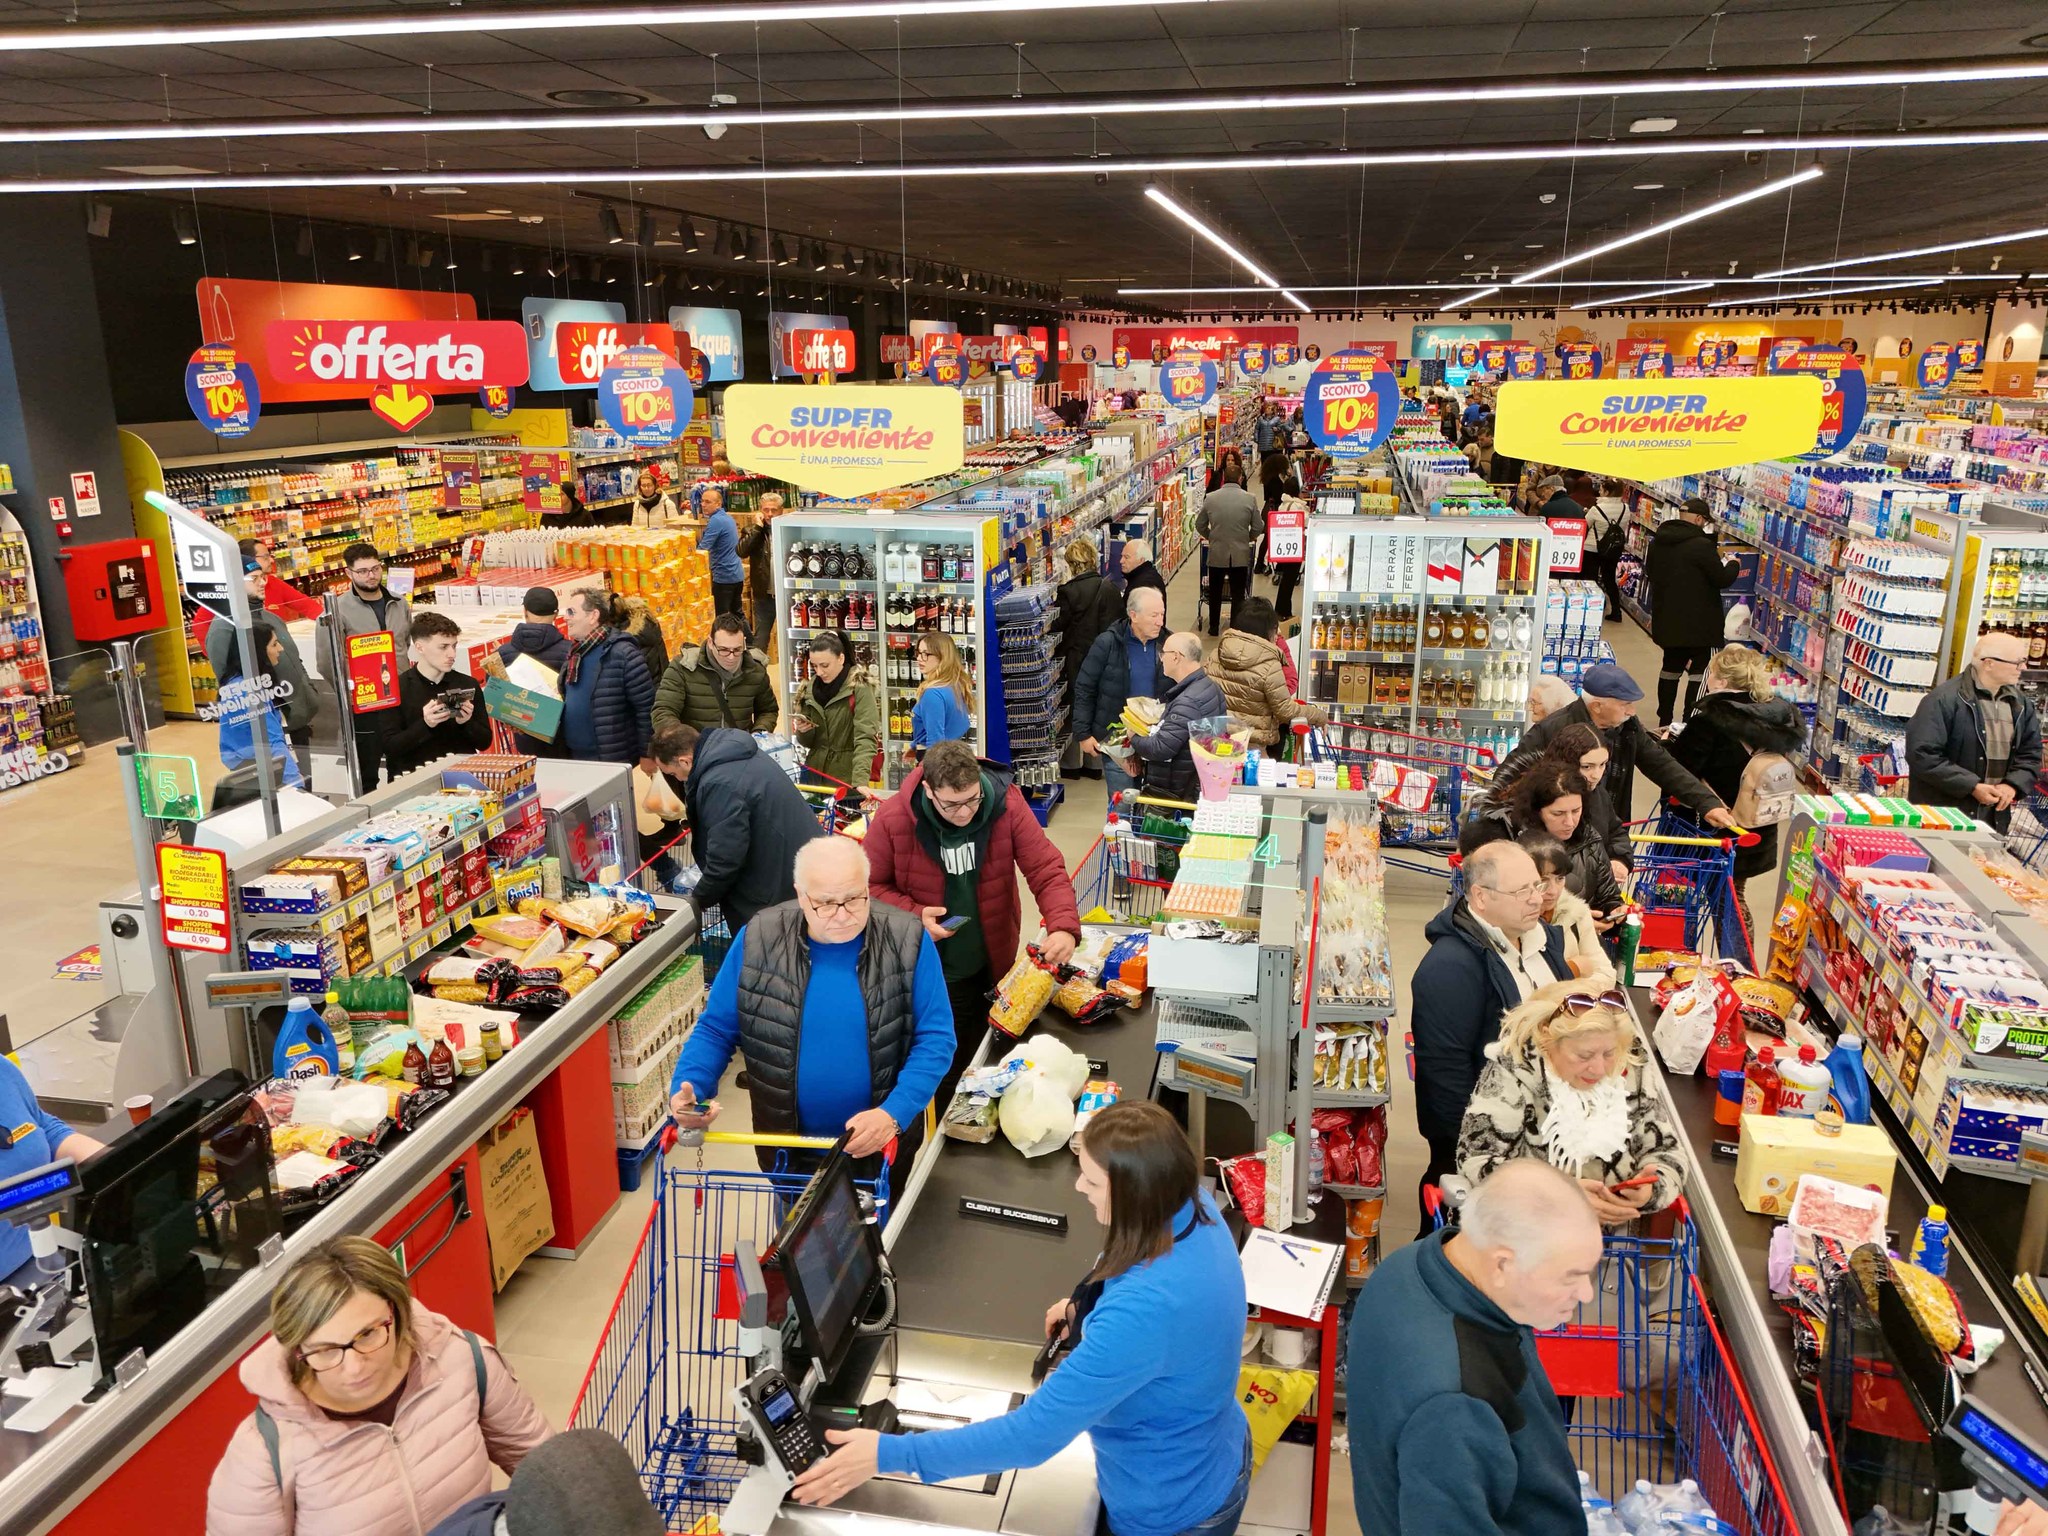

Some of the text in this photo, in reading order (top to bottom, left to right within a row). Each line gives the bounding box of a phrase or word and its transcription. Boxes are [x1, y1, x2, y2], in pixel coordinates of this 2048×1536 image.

[690, 326, 731, 366] Acqua
[804, 333, 847, 370] offeta
[310, 326, 485, 381] offerta
[1960, 353, 1976, 363] 10%
[1019, 363, 1036, 374] 10%
[1246, 357, 1263, 369] 10%
[1489, 357, 1506, 367] 10%
[1518, 361, 1536, 373] 10%
[1644, 360, 1661, 369] SCONTO
[938, 367, 960, 380] 10%
[1170, 368, 1198, 377] SCONTO
[1571, 363, 1593, 379] 10%
[1925, 364, 1948, 380] 10%
[199, 374, 234, 386] SCONTO
[615, 379, 659, 392] SCONTO
[1173, 377, 1204, 396] 10%
[487, 388, 507, 405] 10%
[1322, 384, 1367, 398] SCONTO
[206, 385, 245, 416] 10%
[1602, 395, 1708, 415] SUPER
[622, 392, 671, 423] 10%
[790, 406, 893, 428] SUPER
[1326, 398, 1375, 431] 10%
[1560, 409, 1748, 435] Conveniente
[751, 424, 934, 450] Conveniente
[1614, 439, 1637, 448] UNA
[1637, 439, 1692, 448] PROMESSA
[807, 456, 829, 465] UNA
[831, 456, 883, 466] PROMESSA
[1553, 521, 1581, 531] offerta
[1276, 543, 1298, 556] 6.99
[193, 551, 210, 567] S1
[1387, 536, 1398, 590] FERRARI
[1405, 536, 1416, 590] FERRARI
[1551, 551, 1576, 565] 8.99
[360, 636, 381, 644] SUPER
[357, 683, 376, 695] 8,90
[158, 771, 179, 802] 5
[1252, 833, 1281, 868] 4
[169, 869, 217, 879] BIODEGRADABILE
[172, 875, 216, 884] COMPOSTABILE
[170, 898, 221, 909] SHOPPER CARTA
[357, 899, 369, 911] 1.00
[182, 920, 213, 929] SHOPPER
[331, 913, 344, 926] 1.00
[174, 926, 221, 936] RIUTILIZZABILE
[1979, 1034, 1990, 1045] 35
[2007, 1030, 2048, 1047] PROTEI
[1779, 1090, 1806, 1109] JAX
[966, 1202, 1059, 1225] CLIENTE SUCCESSIVO
